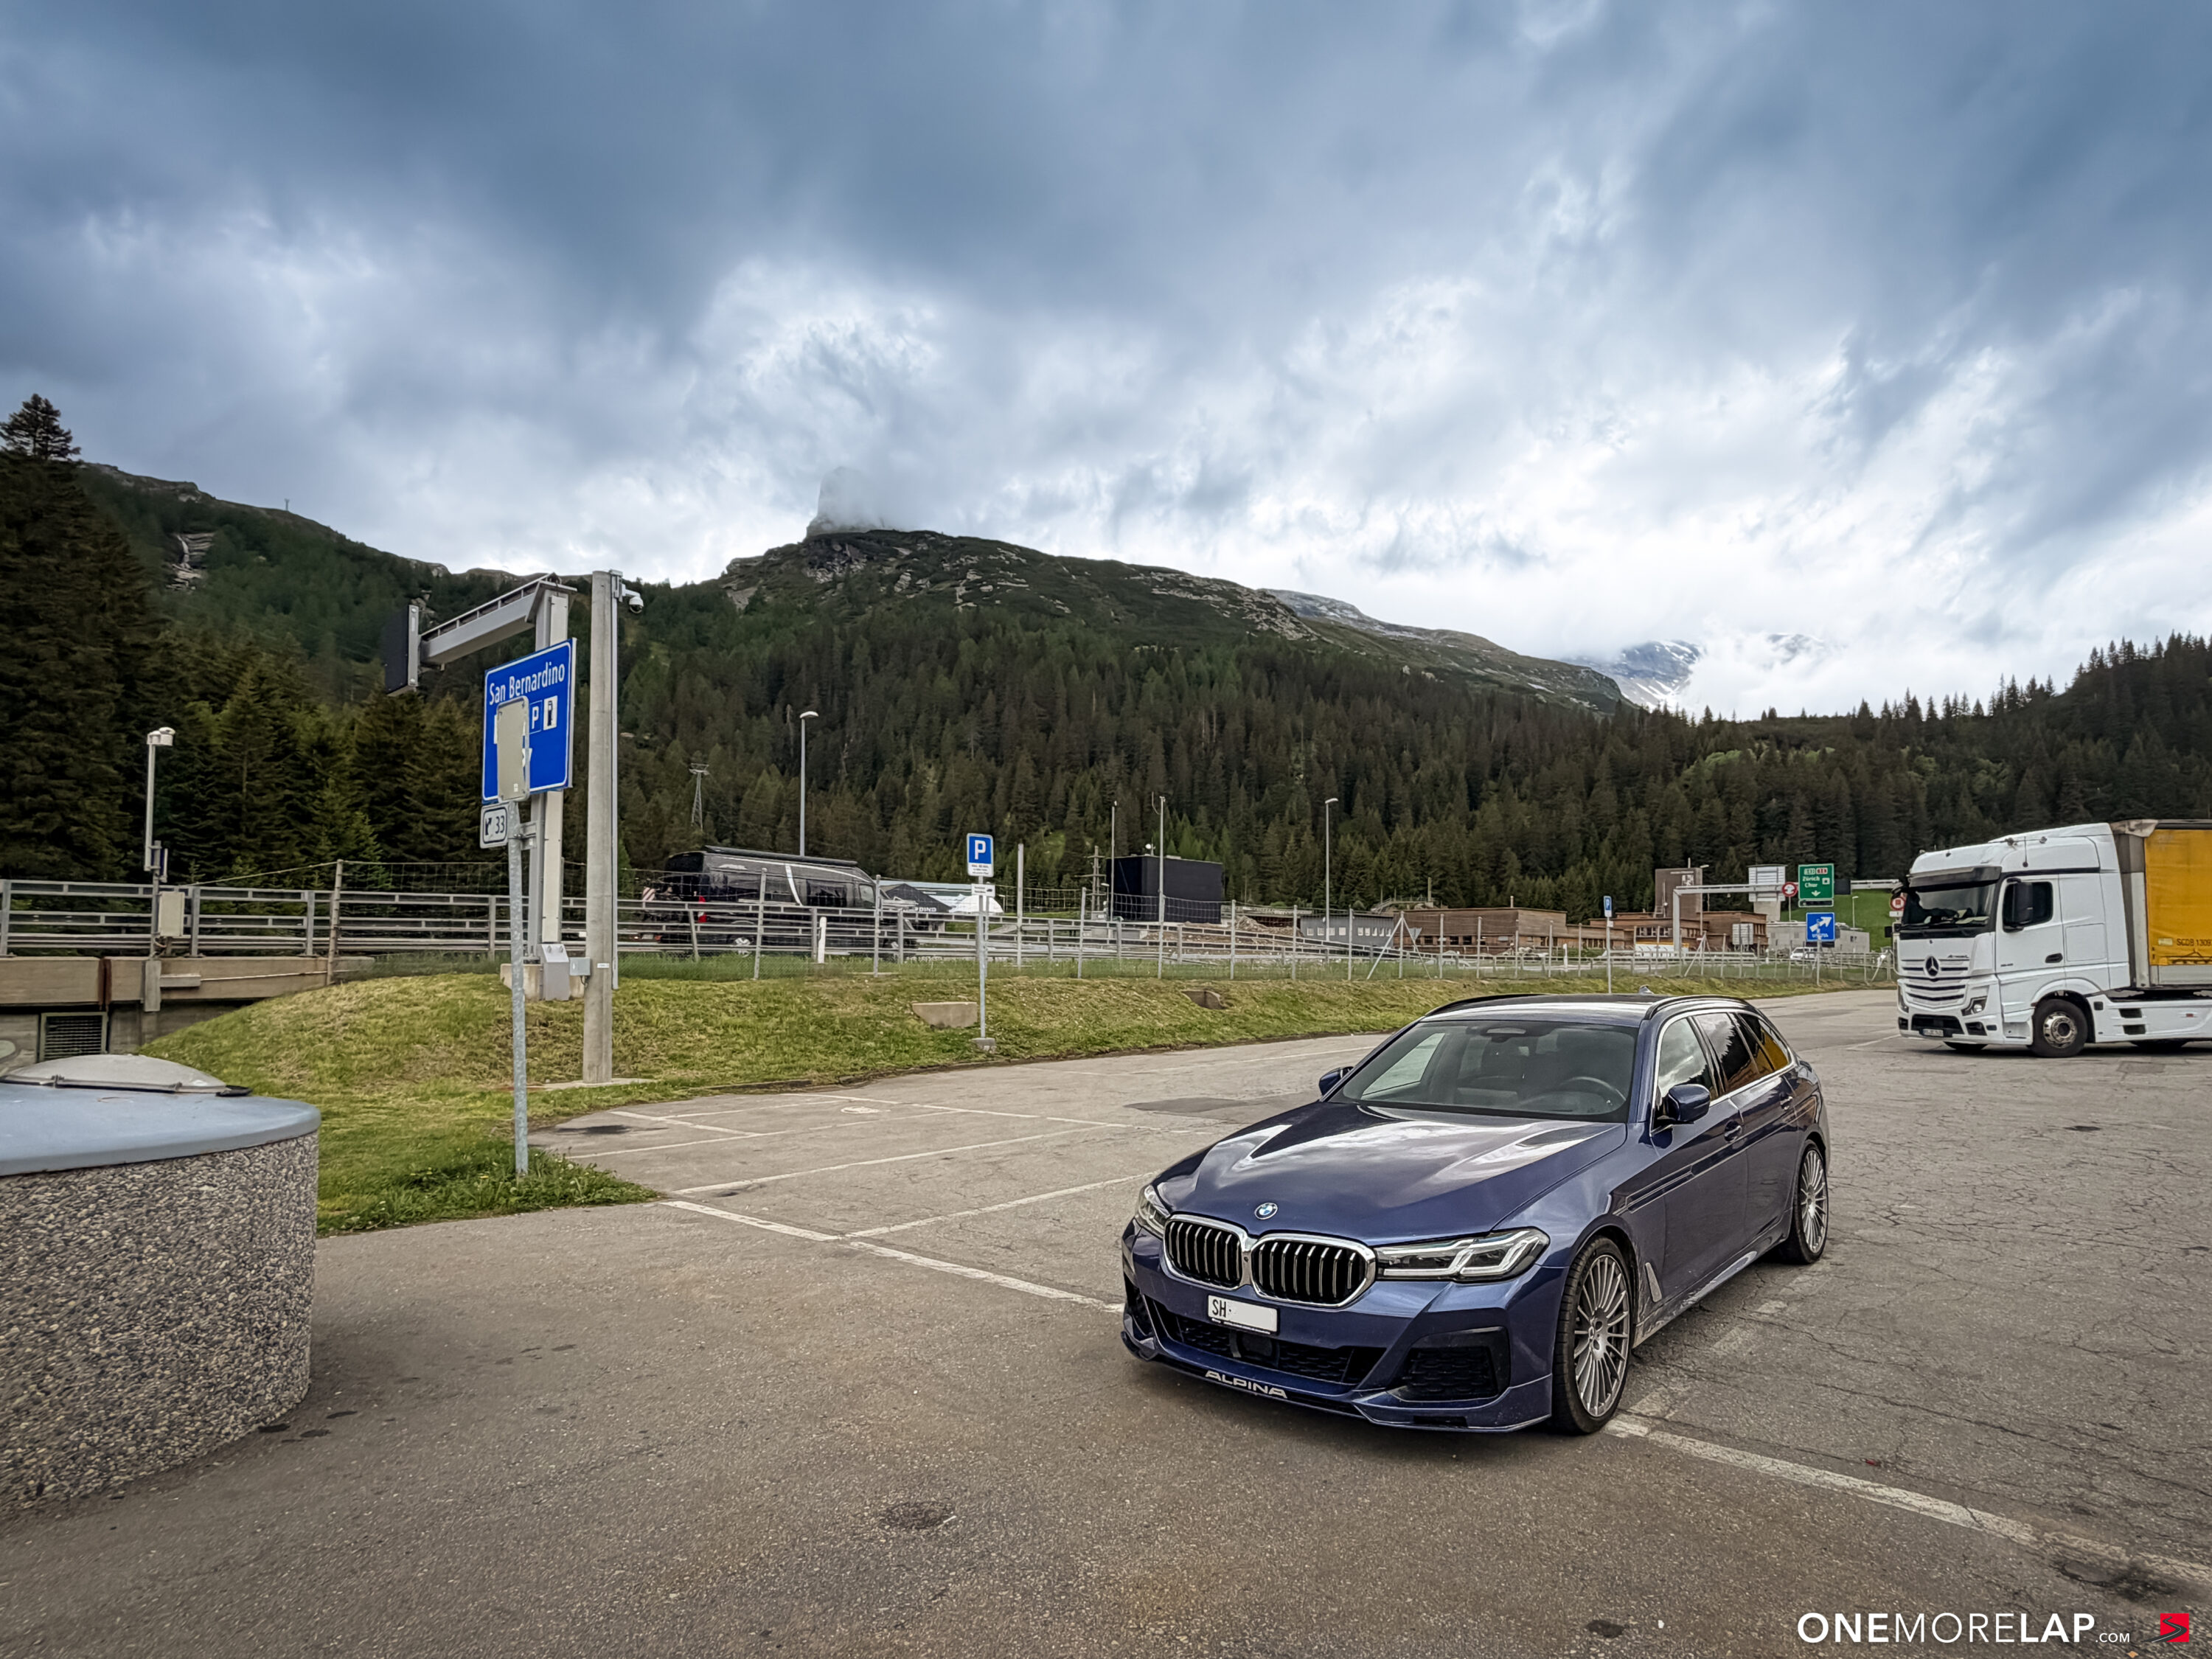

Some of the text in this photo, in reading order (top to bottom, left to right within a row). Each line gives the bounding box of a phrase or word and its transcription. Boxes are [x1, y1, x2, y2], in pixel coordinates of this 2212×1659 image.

[490, 661, 565, 706] San Bernardino
[532, 706, 539, 729] P
[495, 815, 505, 835] 33
[974, 839, 986, 860] P
[1205, 1370, 1288, 1399] ALPINA
